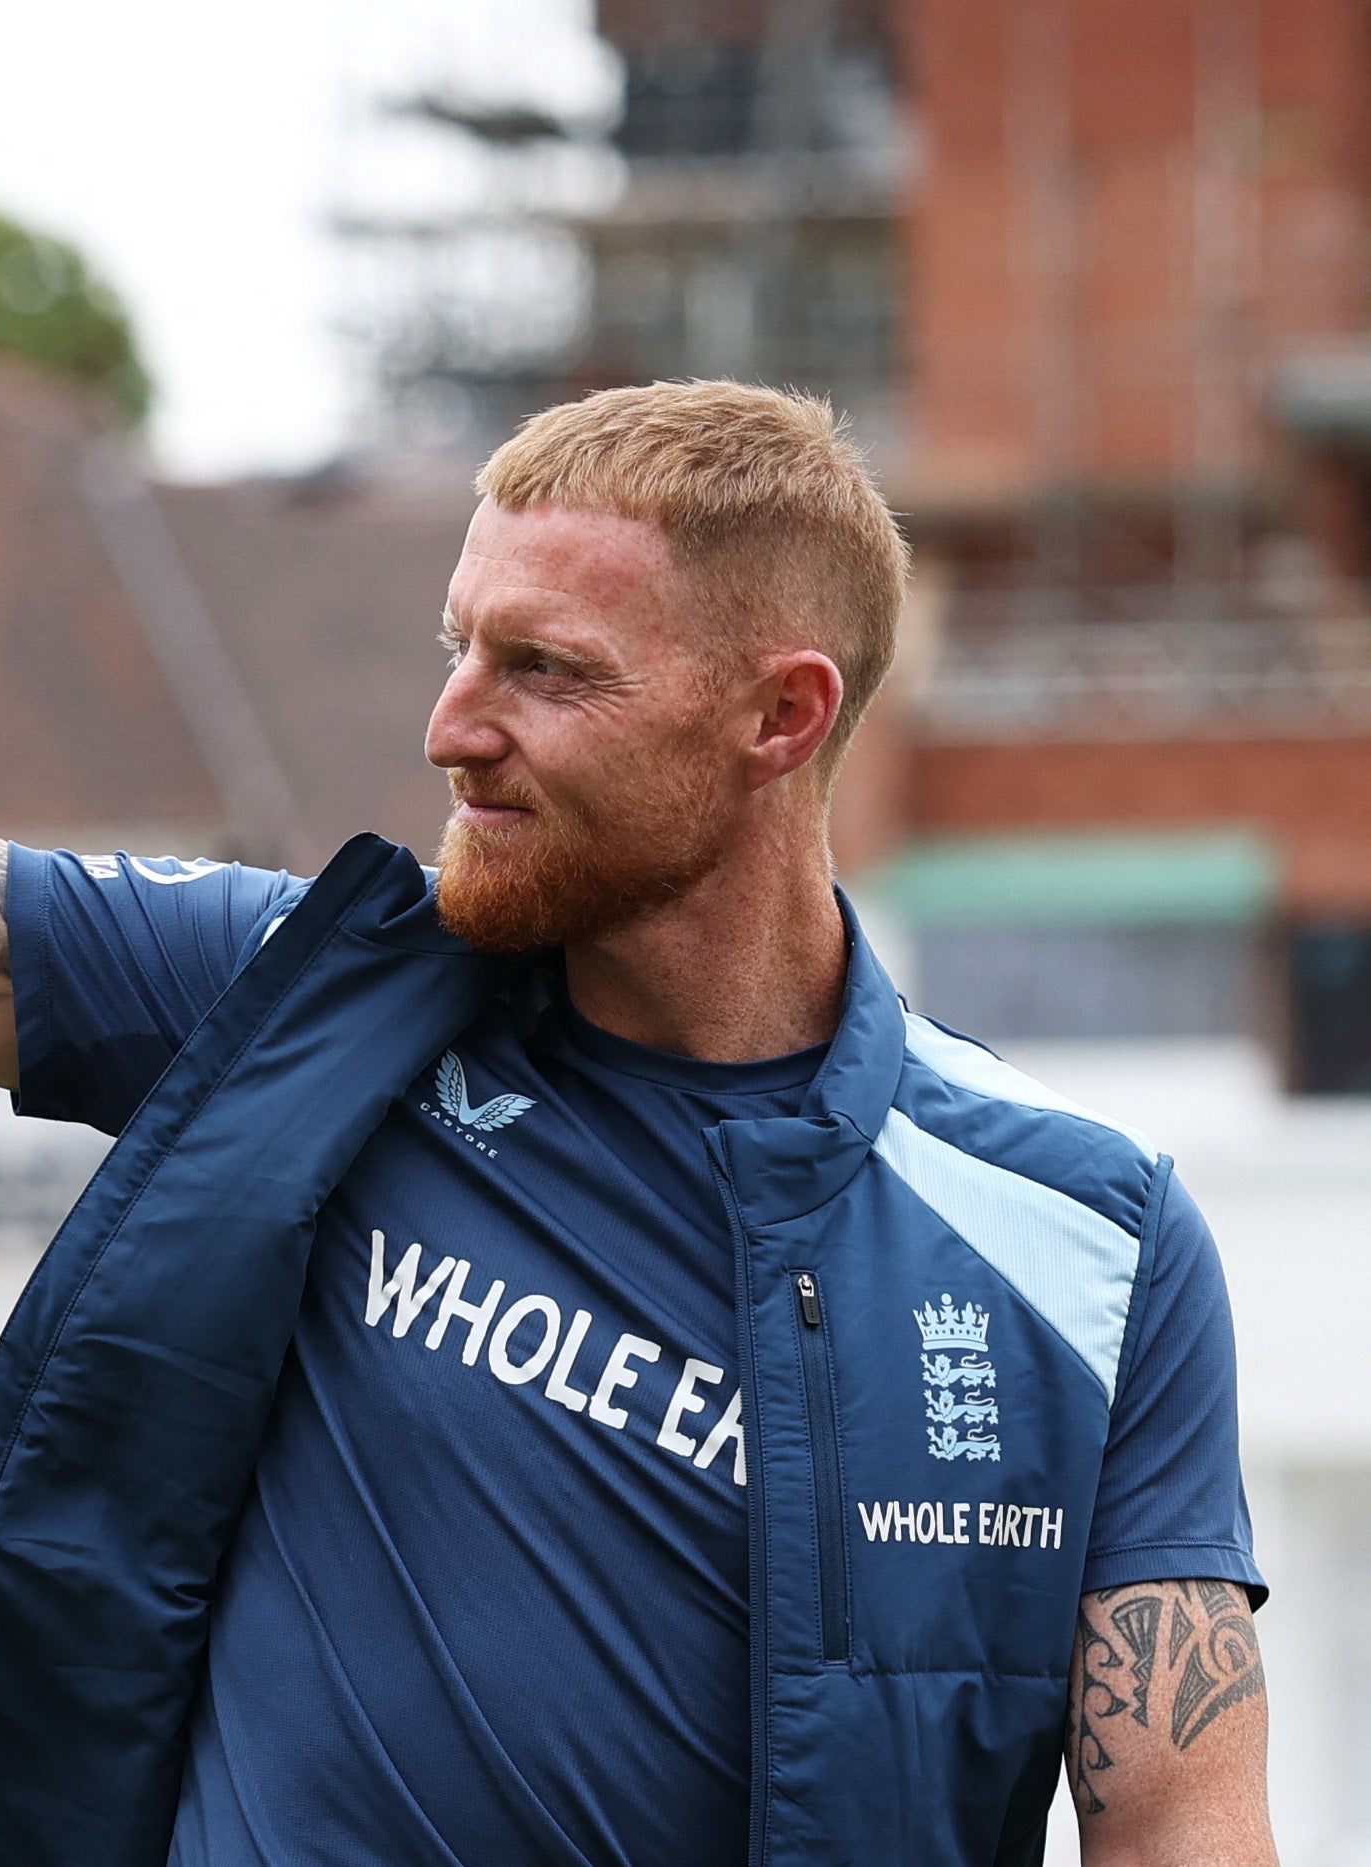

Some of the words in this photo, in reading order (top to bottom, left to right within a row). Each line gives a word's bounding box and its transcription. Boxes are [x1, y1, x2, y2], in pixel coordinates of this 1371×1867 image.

[420, 1102, 498, 1159] CASTORE
[364, 1229, 662, 1429] WHOLE
[857, 1500, 971, 1544] WHOLE
[979, 1502, 1063, 1549] EARTH
